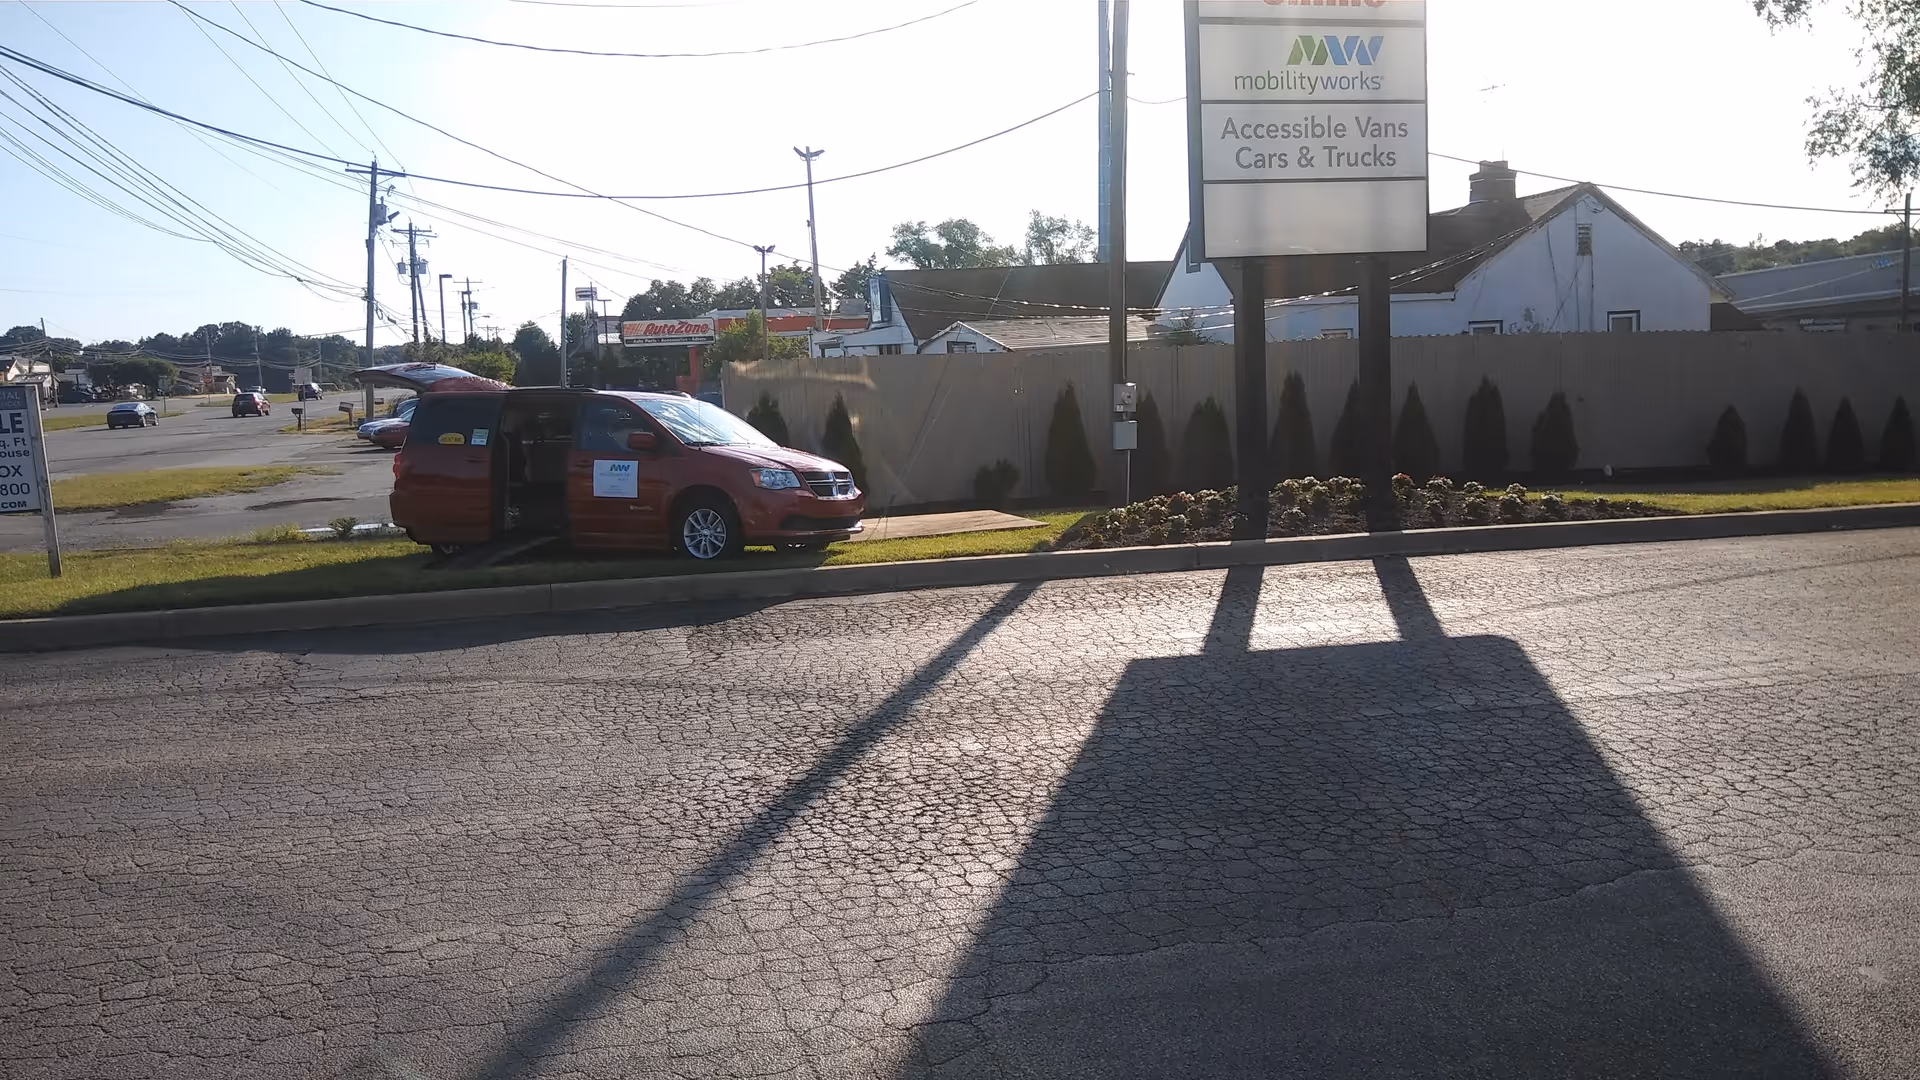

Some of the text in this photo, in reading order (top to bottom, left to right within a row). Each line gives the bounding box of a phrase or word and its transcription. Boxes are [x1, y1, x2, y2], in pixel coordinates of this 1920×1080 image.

[1234, 70, 1381, 95] mobilityworks
[1220, 115, 1409, 140] Accessible Vans
[1235, 144, 1397, 169] Cars & Trucks
[643, 321, 709, 336] AutoZone
[13, 437, 27, 447] Ft
[0, 449, 30, 458] ouse
[0, 464, 24, 478] OX
[0, 482, 30, 496] 800
